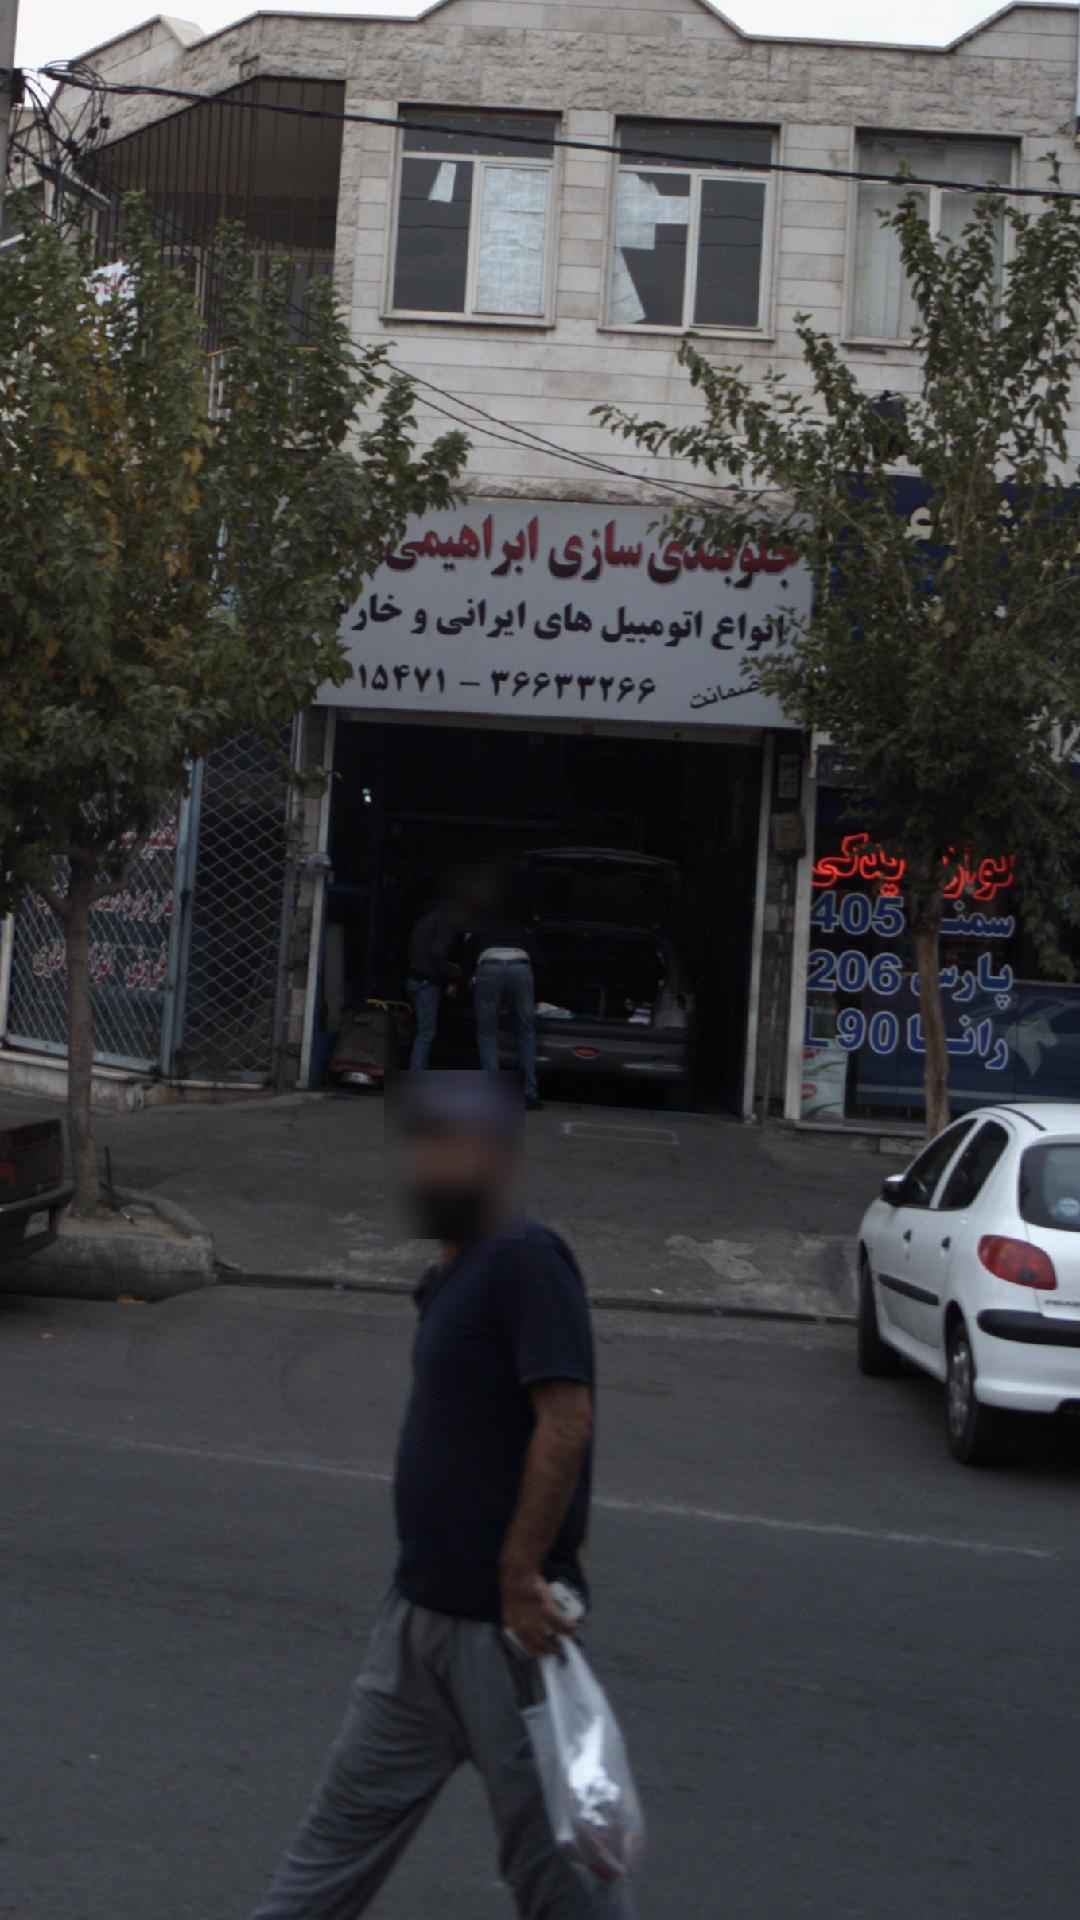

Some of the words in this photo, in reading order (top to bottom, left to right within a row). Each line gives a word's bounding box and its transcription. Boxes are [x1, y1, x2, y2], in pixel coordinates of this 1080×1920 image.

[386, 514, 539, 575] ابراهیمی
[547, 519, 643, 582] سازی
[335, 592, 403, 631] خار
[410, 606, 427, 634] و
[436, 598, 526, 639] ایرانی
[533, 603, 593, 641] های
[601, 607, 703, 648] اتومبیل
[710, 612, 785, 651] انواع
[490, 669, 657, 705] ۳۶۶۳۳۲۶۶
[810, 889, 907, 938] 405
[939, 900, 1016, 938] سمن
[806, 948, 904, 996] 206
[803, 1006, 901, 1055] L90
